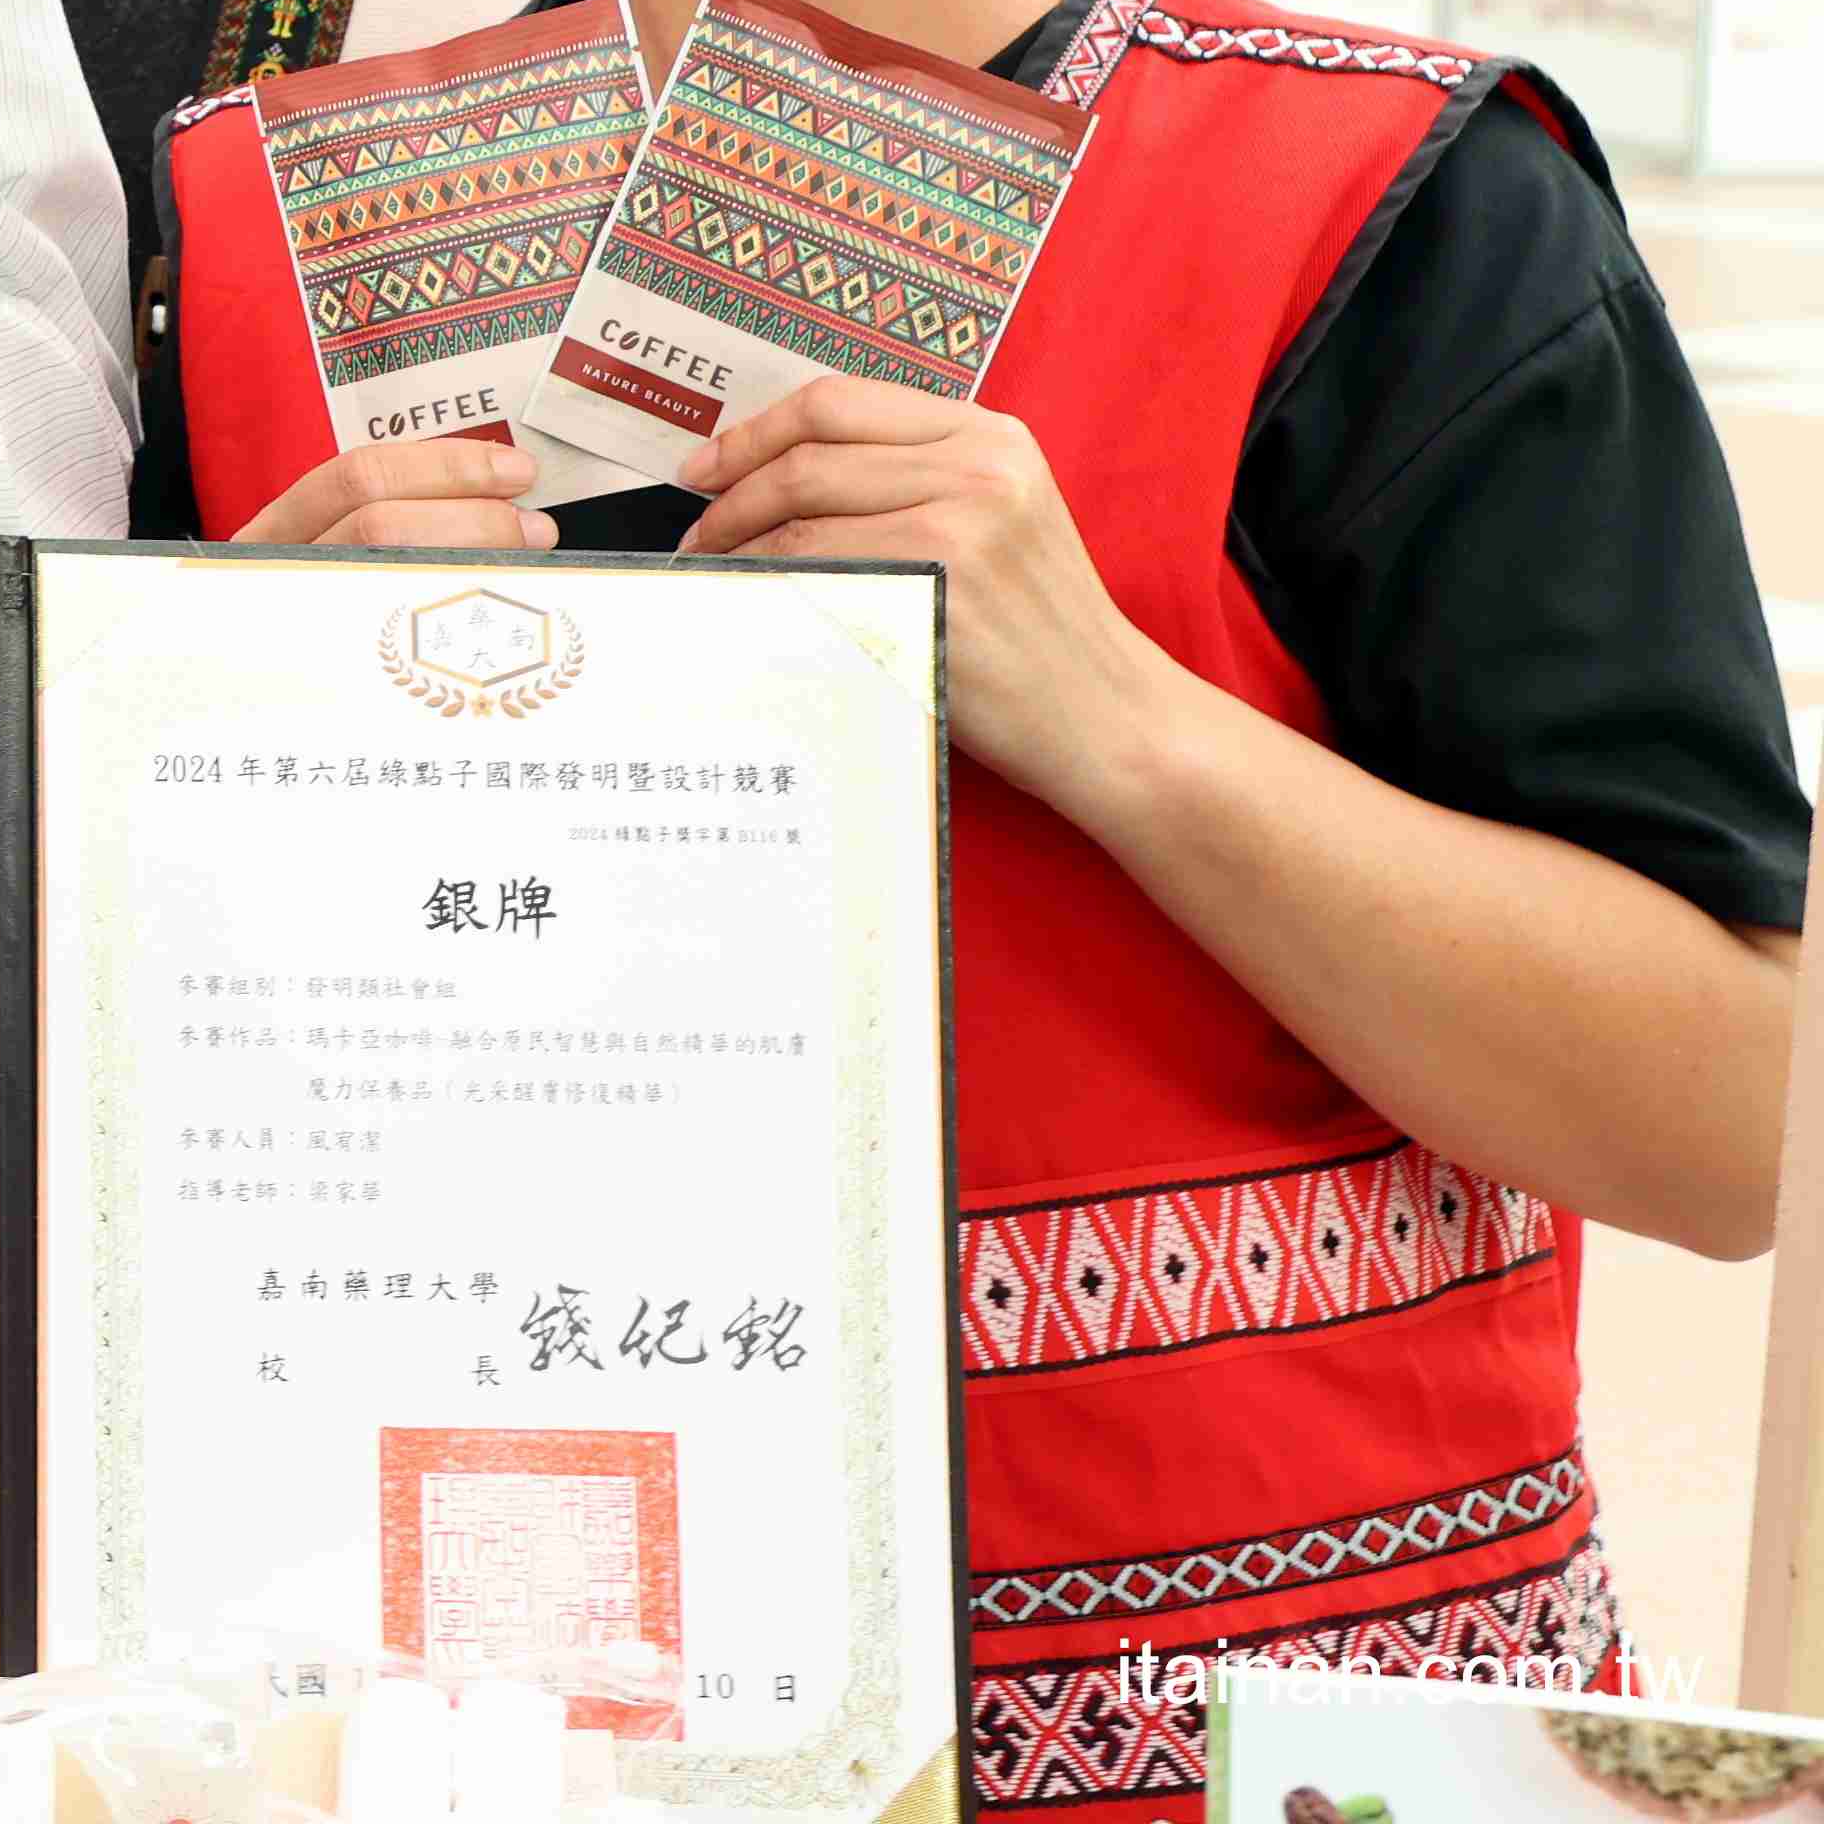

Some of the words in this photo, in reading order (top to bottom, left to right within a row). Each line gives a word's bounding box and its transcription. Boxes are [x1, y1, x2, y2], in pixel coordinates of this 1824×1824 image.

[599, 319, 734, 391] COFFEE
[367, 387, 499, 441] COFFEE
[581, 362, 640, 394] NATURE
[643, 388, 701, 420] BEAUTY
[465, 648, 496, 668] 大
[153, 753, 222, 785] 2024
[420, 876, 559, 941] 銀牌
[256, 1267, 502, 1305] 嘉南藥理大學
[519, 1283, 809, 1373] 錢紀銘
[257, 1354, 289, 1385] 校
[470, 1353, 501, 1388] 長
[696, 1673, 734, 1700] 10
[774, 1673, 797, 1704] 日
